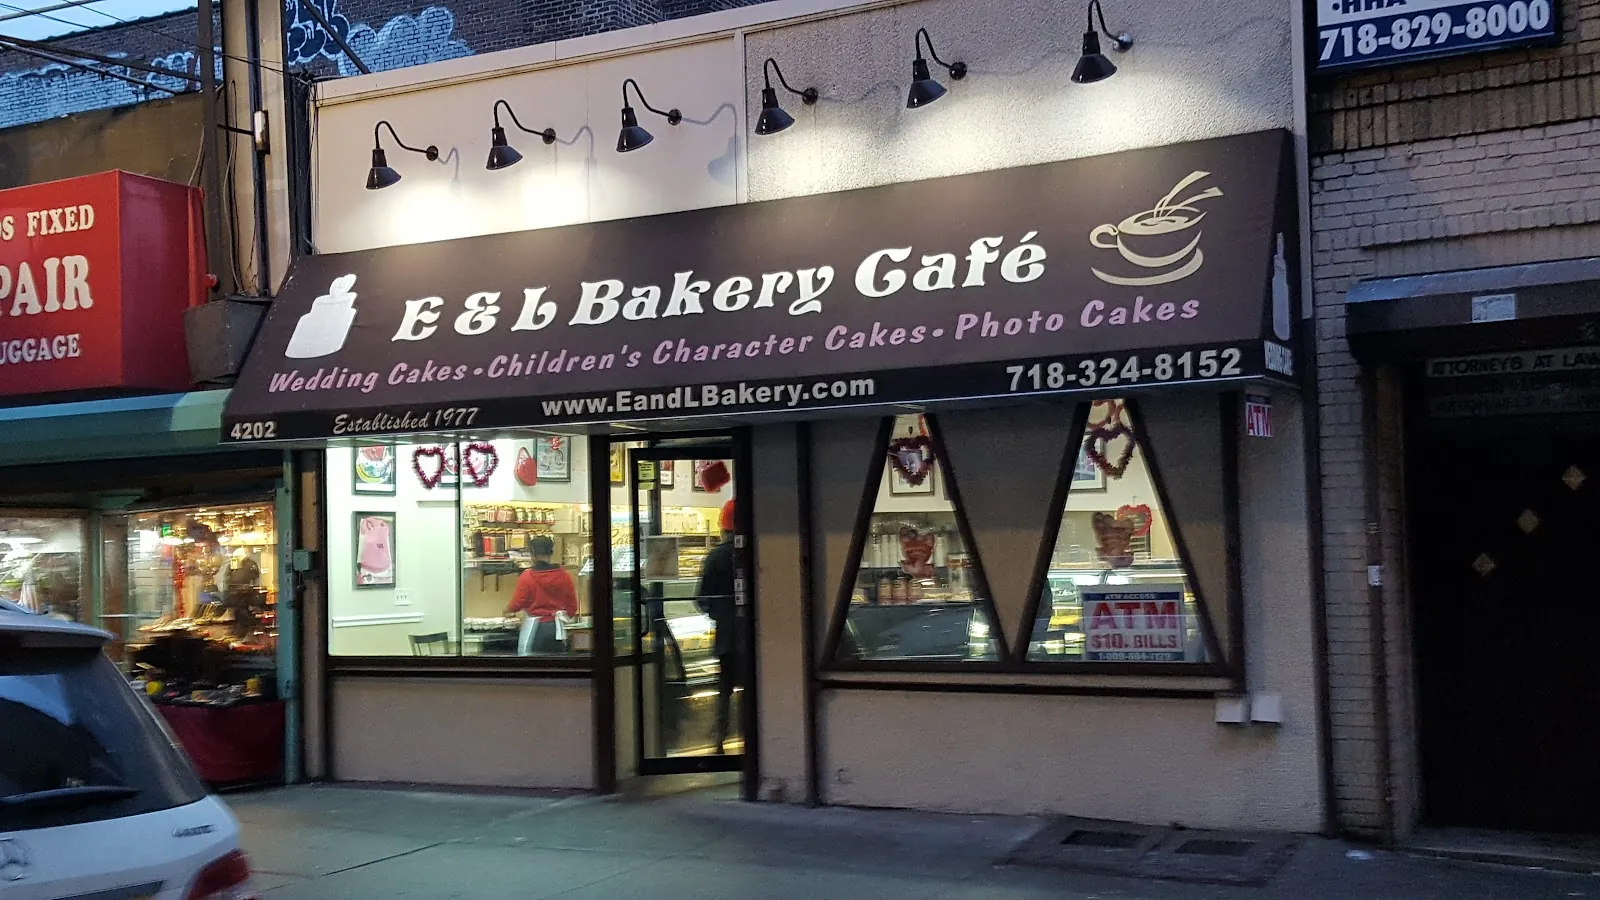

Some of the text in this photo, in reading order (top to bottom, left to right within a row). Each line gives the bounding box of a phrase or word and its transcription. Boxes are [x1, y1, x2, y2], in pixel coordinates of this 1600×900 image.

[1318, 0, 1550, 61] 718-829-8000
[0, 204, 95, 241] S FIXED
[391, 231, 1047, 342] E & L Bakery Café
[269, 296, 1200, 393] Wedding Cakes Children's Character Cakes Photo Cakes
[1006, 347, 1242, 391] 718-324-8152
[541, 377, 876, 416] www.EandLBakery.com
[230, 421, 277, 440] 4202
[333, 407, 480, 435] Established 1977
[1247, 404, 1273, 436] ATM
[1090, 602, 1177, 629] ATM
[1091, 633, 1177, 649] $10. BILLS
